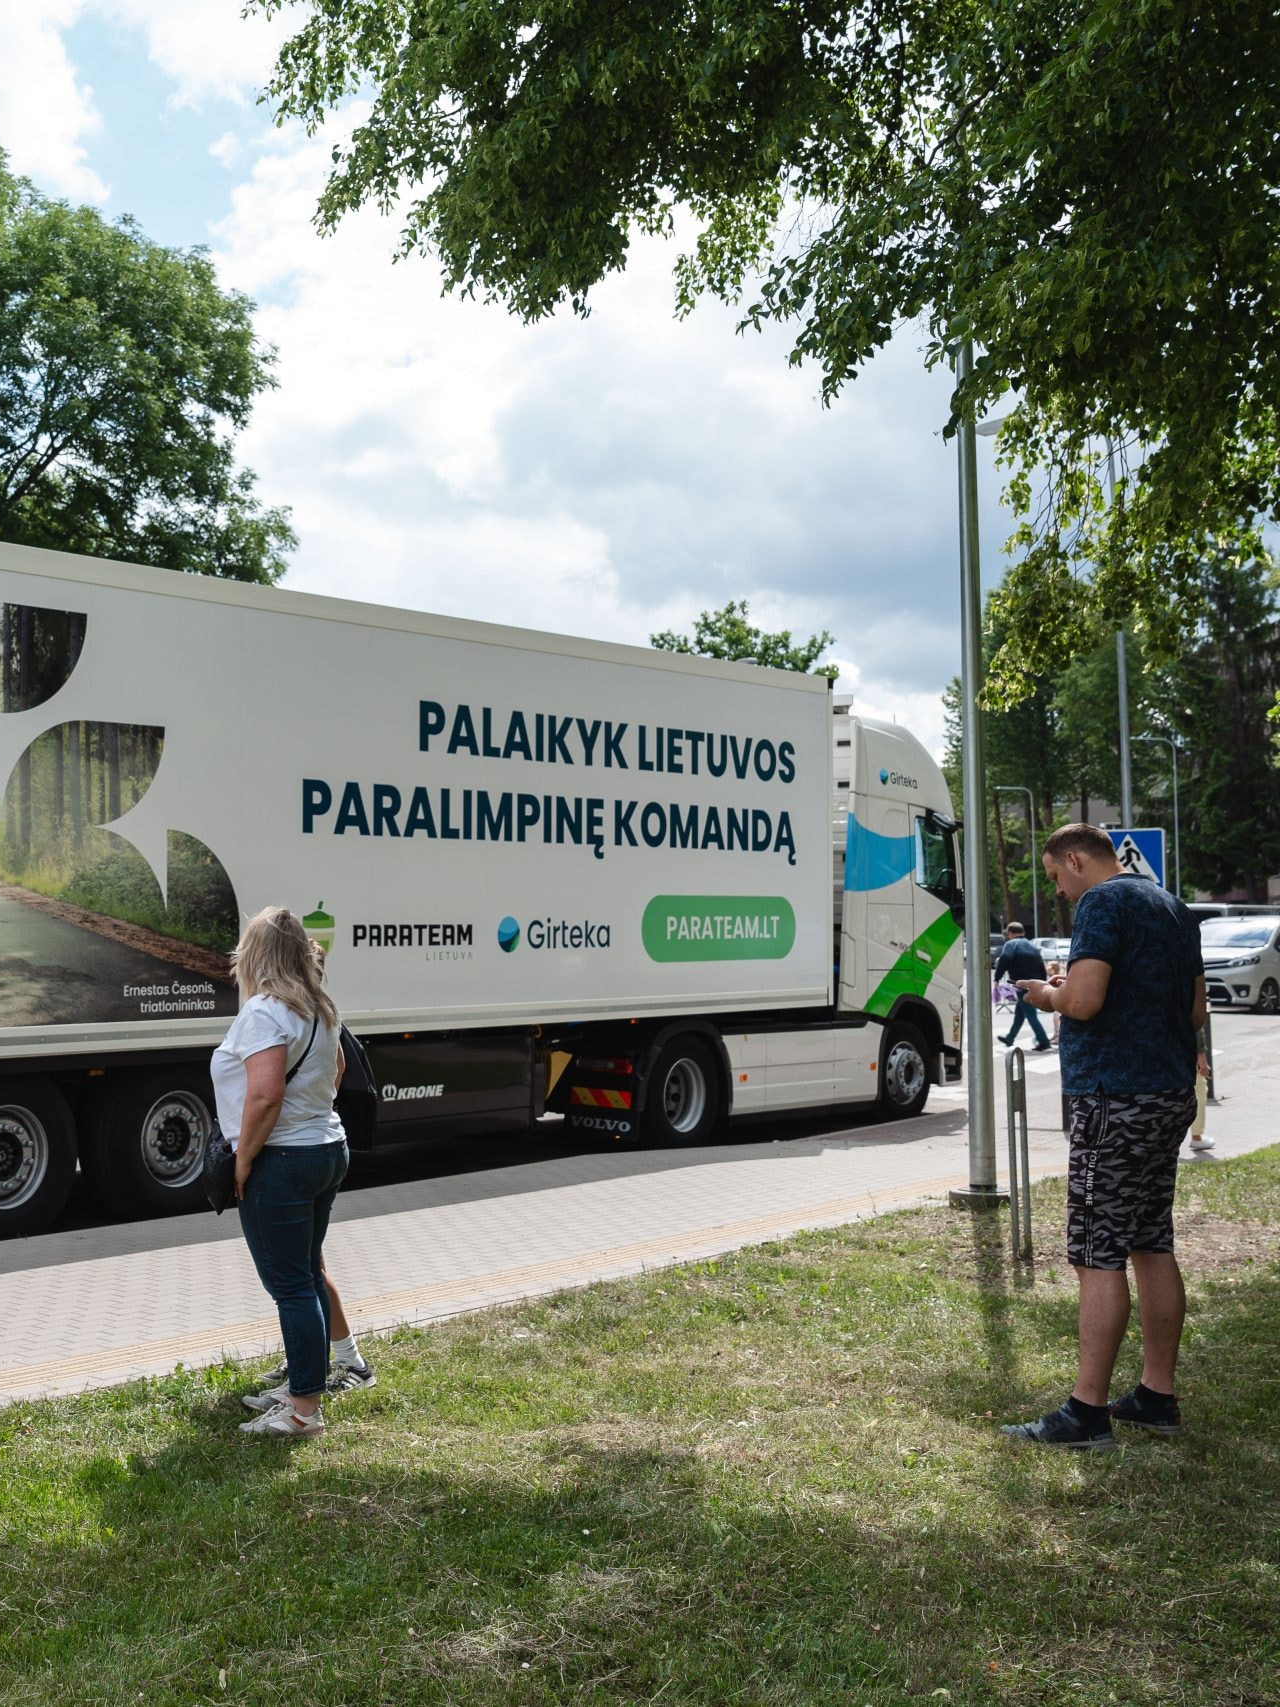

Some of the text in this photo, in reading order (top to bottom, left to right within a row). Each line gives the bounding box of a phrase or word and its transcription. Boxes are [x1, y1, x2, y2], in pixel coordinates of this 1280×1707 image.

[419, 700, 796, 784] PALAIKYK LIETUVOS
[889, 771, 918, 789] Girteka
[302, 778, 797, 866] PARALIMPINĘ KOMANDĄ
[352, 923, 473, 947] PARATEAM
[527, 917, 611, 950] Girteka
[666, 915, 780, 941] PARATEAM.LT
[425, 951, 473, 961] LIETUVA
[123, 980, 216, 997] Ernestas Česonis,
[140, 998, 215, 1013] triatlonininkas
[397, 1084, 445, 1100] KRONE
[571, 1114, 631, 1133] VOLVO
[1085, 1149, 1098, 1206] YOU AND ME
